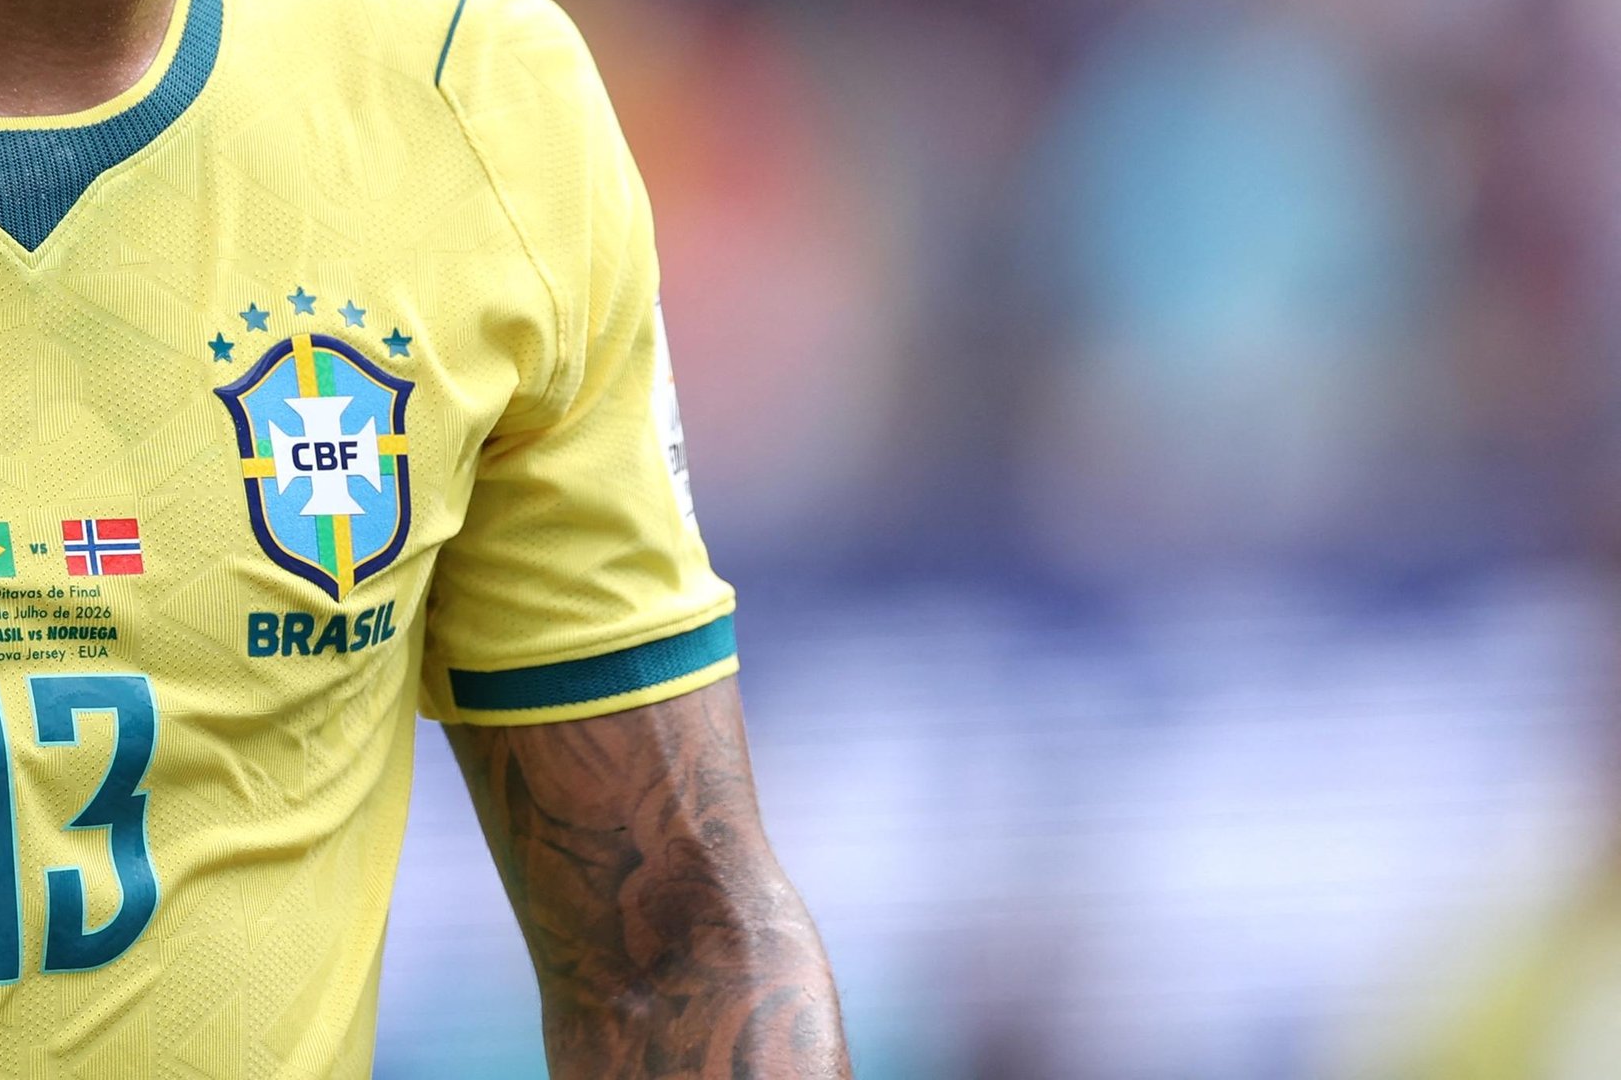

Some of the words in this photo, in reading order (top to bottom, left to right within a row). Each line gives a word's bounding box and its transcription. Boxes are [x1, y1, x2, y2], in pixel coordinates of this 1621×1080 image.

[291, 441, 359, 471] CBF
[29, 543, 48, 555] vs
[47, 585, 64, 599] de
[69, 584, 101, 598] Final
[14, 606, 48, 621] Julho
[53, 605, 70, 619] de
[75, 606, 112, 619] 2026
[27, 629, 43, 642] vs
[47, 626, 118, 641] NORUEGA
[247, 600, 397, 658] BRASIL
[25, 648, 66, 663] Jersey
[79, 645, 109, 658] EUA
